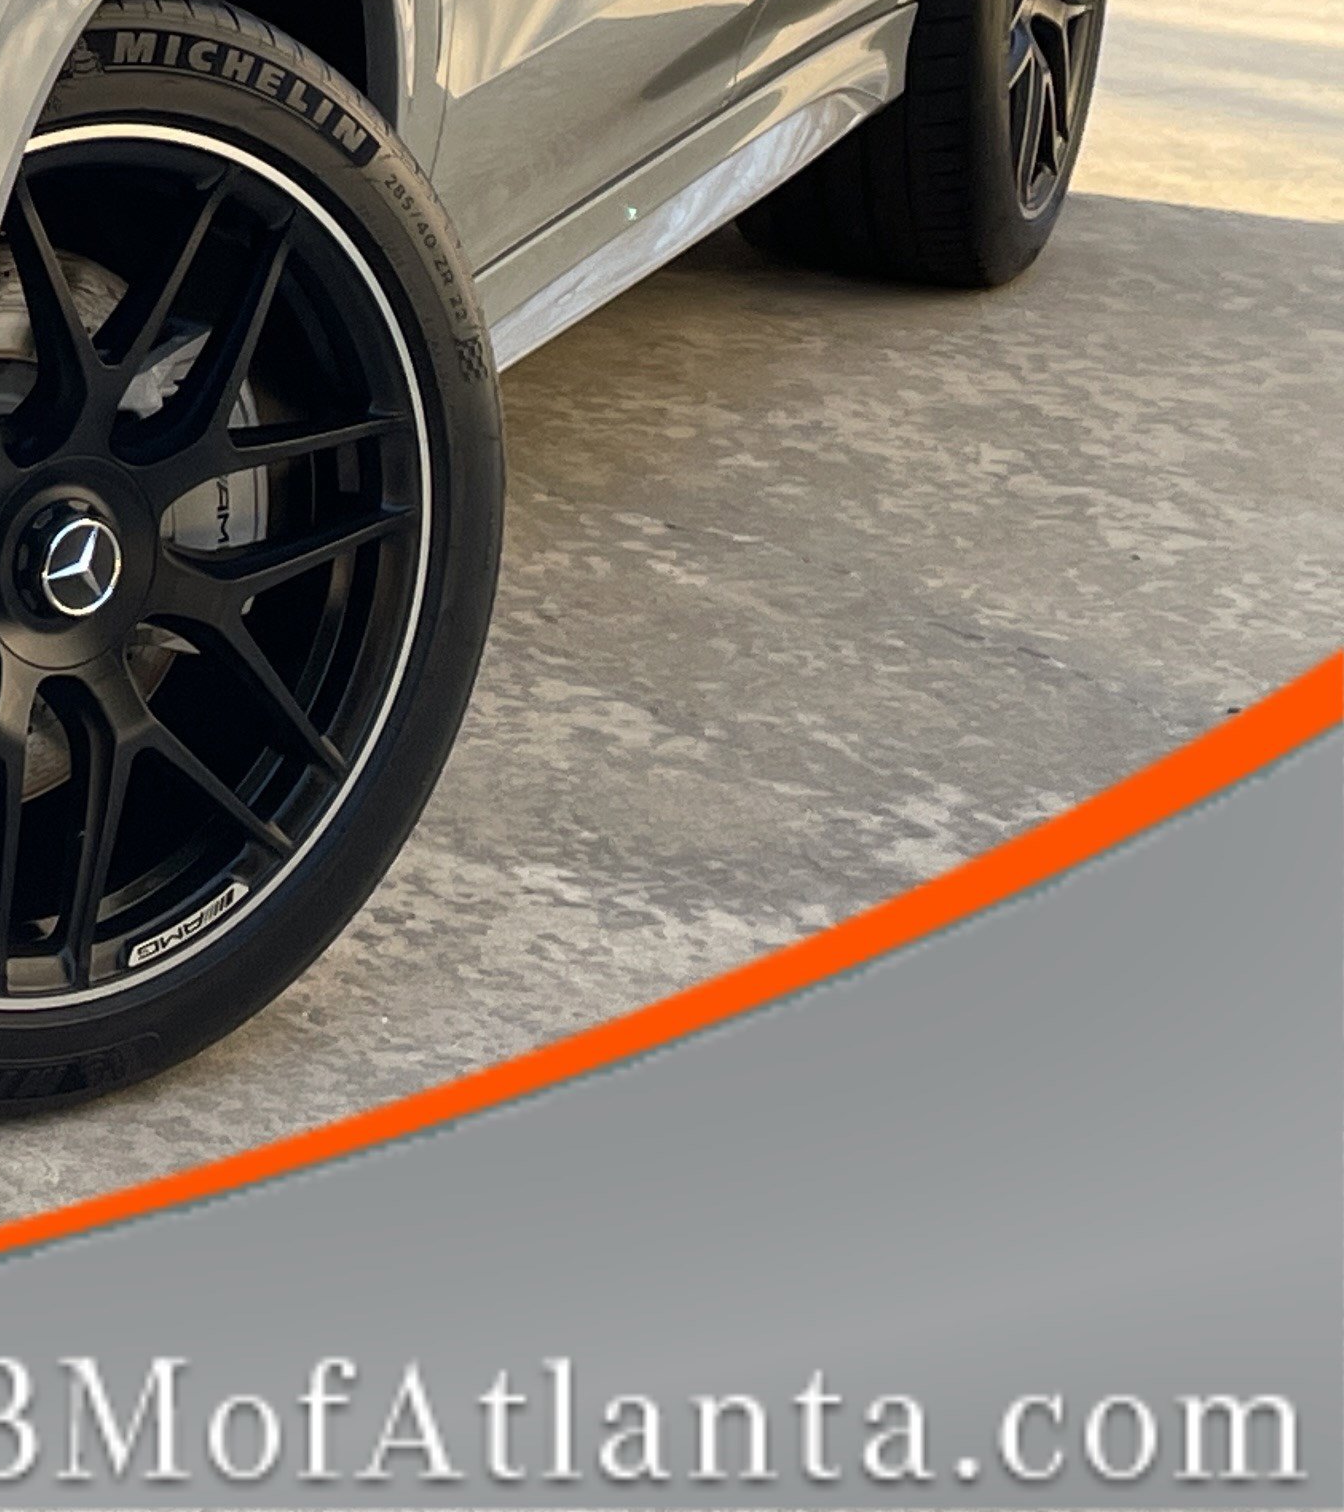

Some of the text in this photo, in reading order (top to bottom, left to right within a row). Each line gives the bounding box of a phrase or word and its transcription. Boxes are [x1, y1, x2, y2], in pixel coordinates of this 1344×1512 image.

[113, 31, 370, 155] MICHELIN
[384, 174, 437, 249] 285/40
[217, 481, 229, 544] AM
[137, 912, 204, 960] AMG
